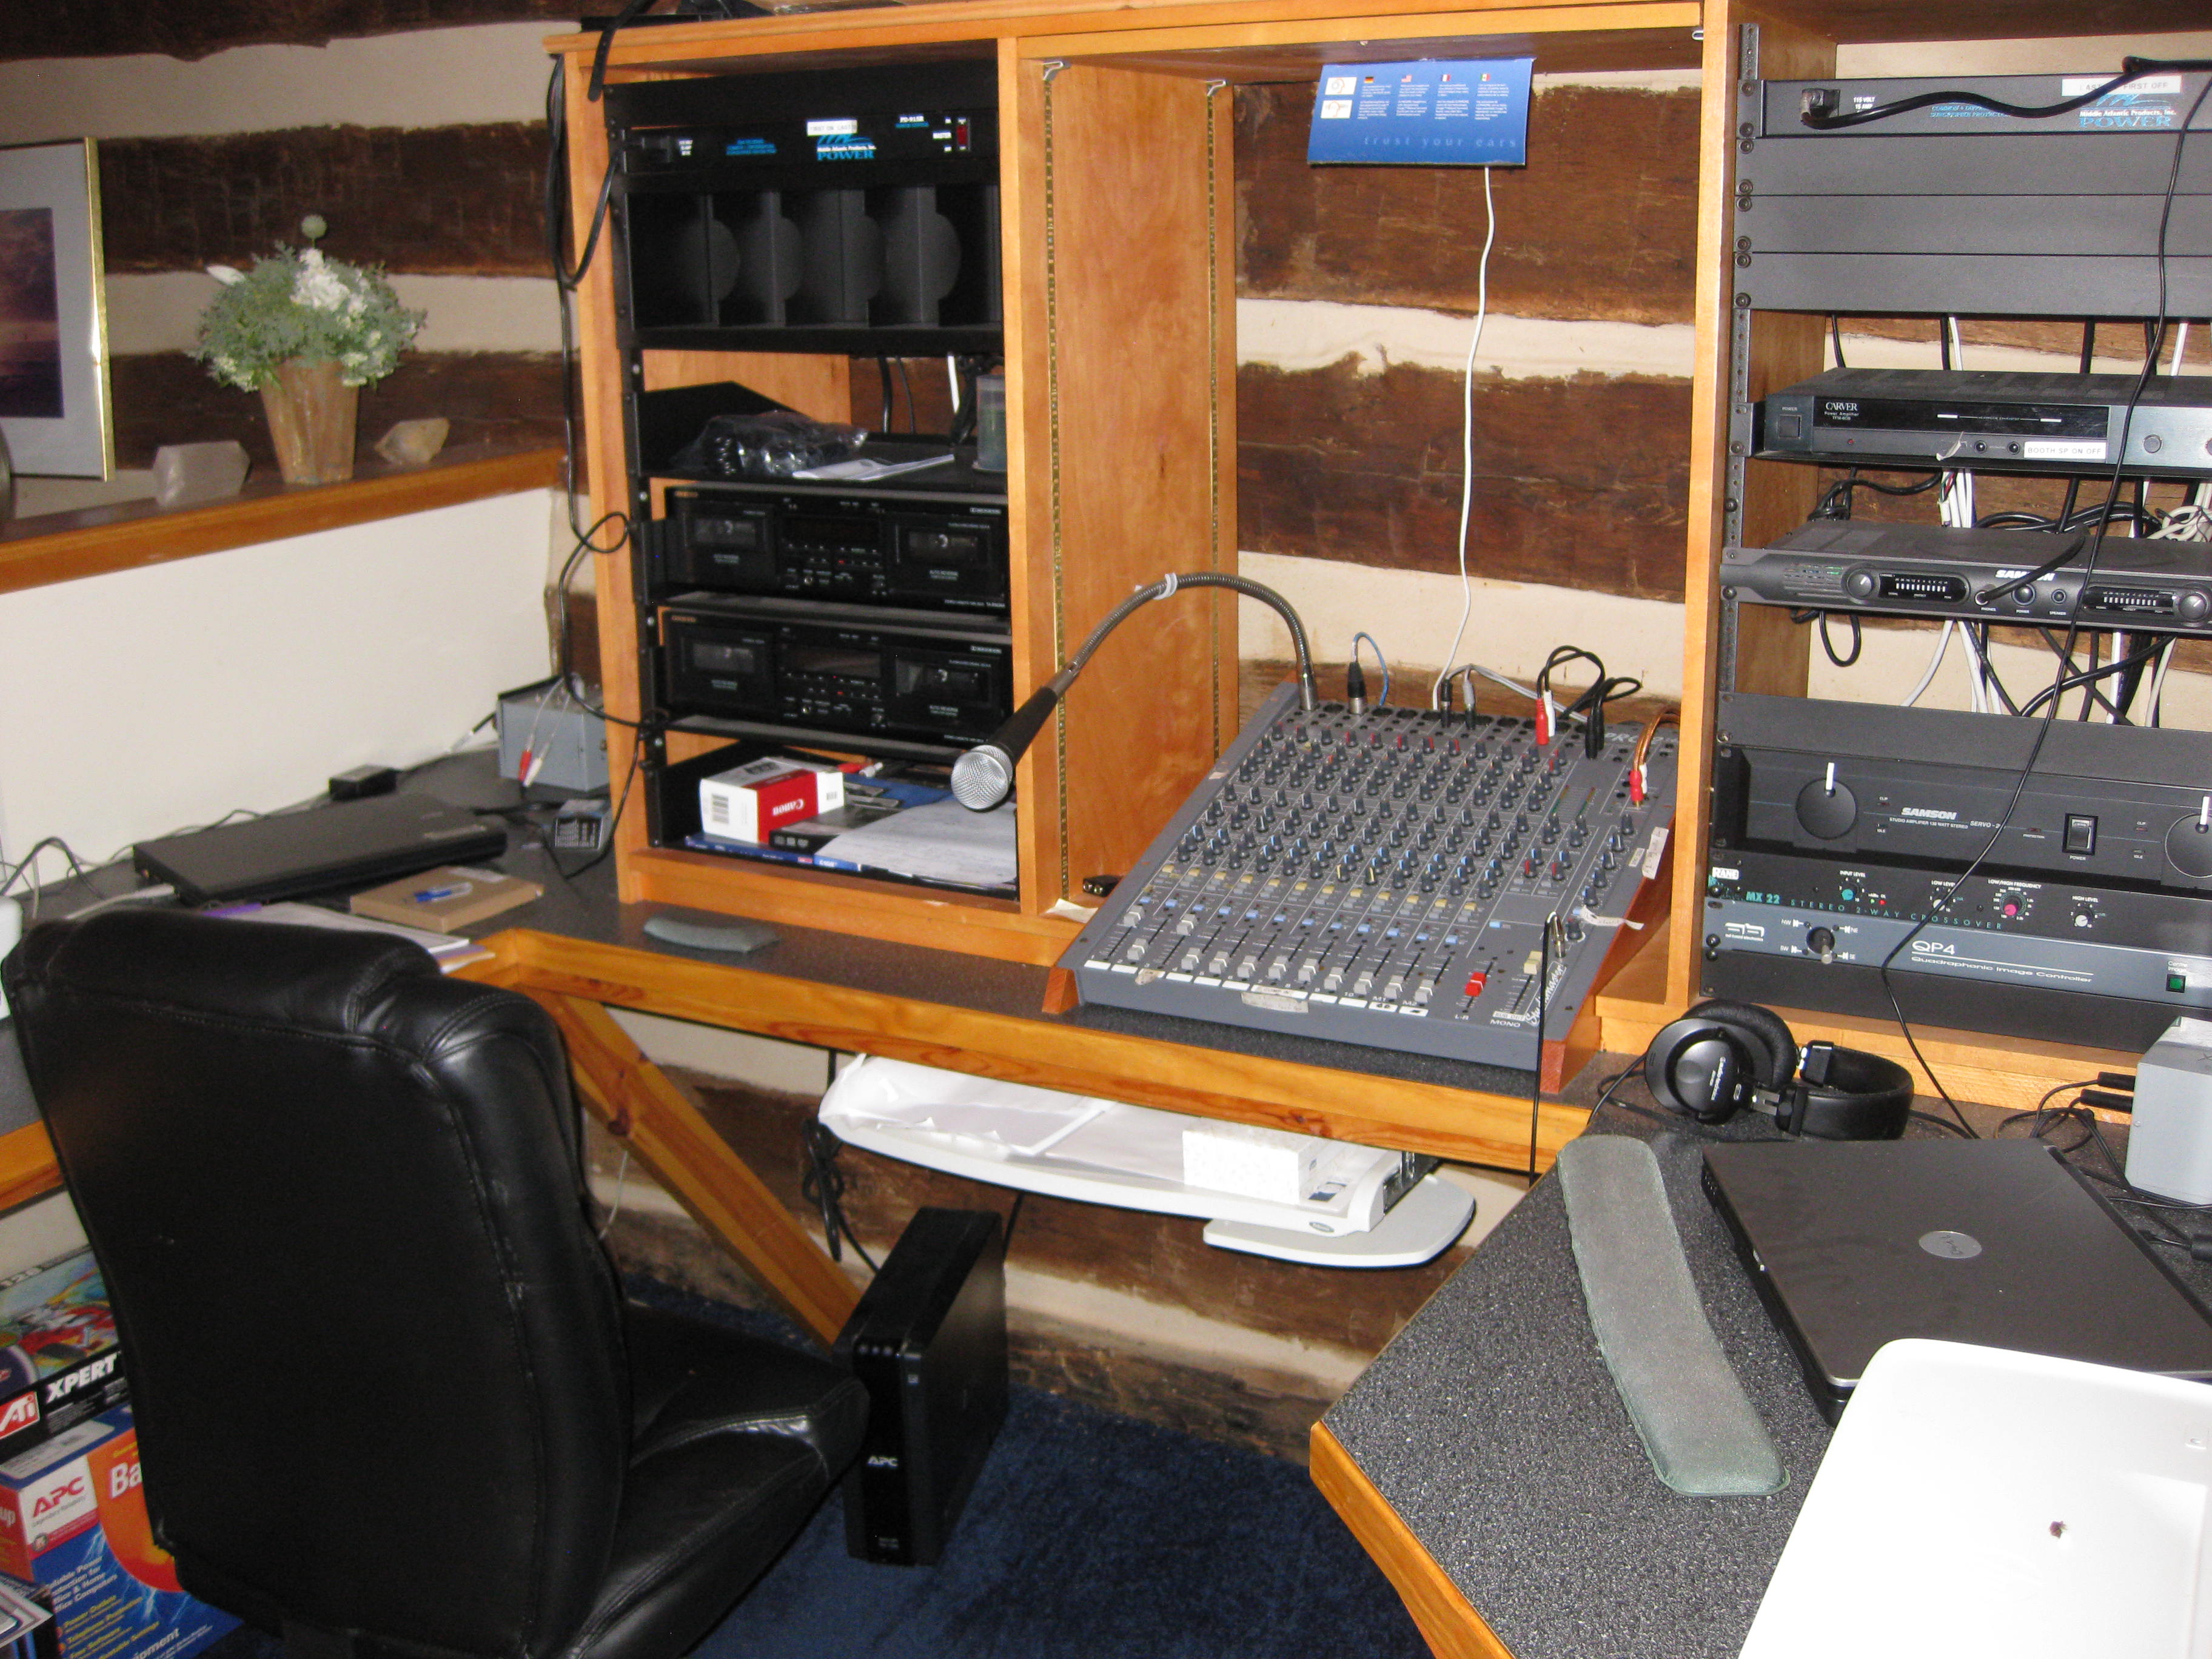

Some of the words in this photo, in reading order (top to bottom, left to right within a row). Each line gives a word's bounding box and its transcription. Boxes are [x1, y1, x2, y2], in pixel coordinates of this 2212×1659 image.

[2079, 116, 2172, 128] POWER
[1423, 138, 1463, 148] your
[817, 150, 874, 161] POWER
[1825, 401, 1858, 411] CARVER
[1996, 570, 2056, 581] SAMN
[772, 798, 805, 817] Canon
[1901, 807, 1957, 820] SAMSON
[1714, 868, 1738, 879] RANE
[1746, 891, 1763, 903] MX
[1766, 893, 1780, 905] 22
[1791, 899, 1845, 911] STEREO
[1911, 913, 2002, 930] CROSSOVER
[1911, 940, 1956, 955] QP4
[1911, 956, 1994, 971] Quadraphonic
[1996, 967, 2034, 976] Image
[2036, 971, 2093, 983] Controller
[1490, 1019, 1521, 1028] MONO
[46, 1352, 118, 1404] XPERT
[867, 1456, 899, 1468] APC
[33, 1476, 85, 1518] APC
[74, 1574, 118, 1602] Computers
